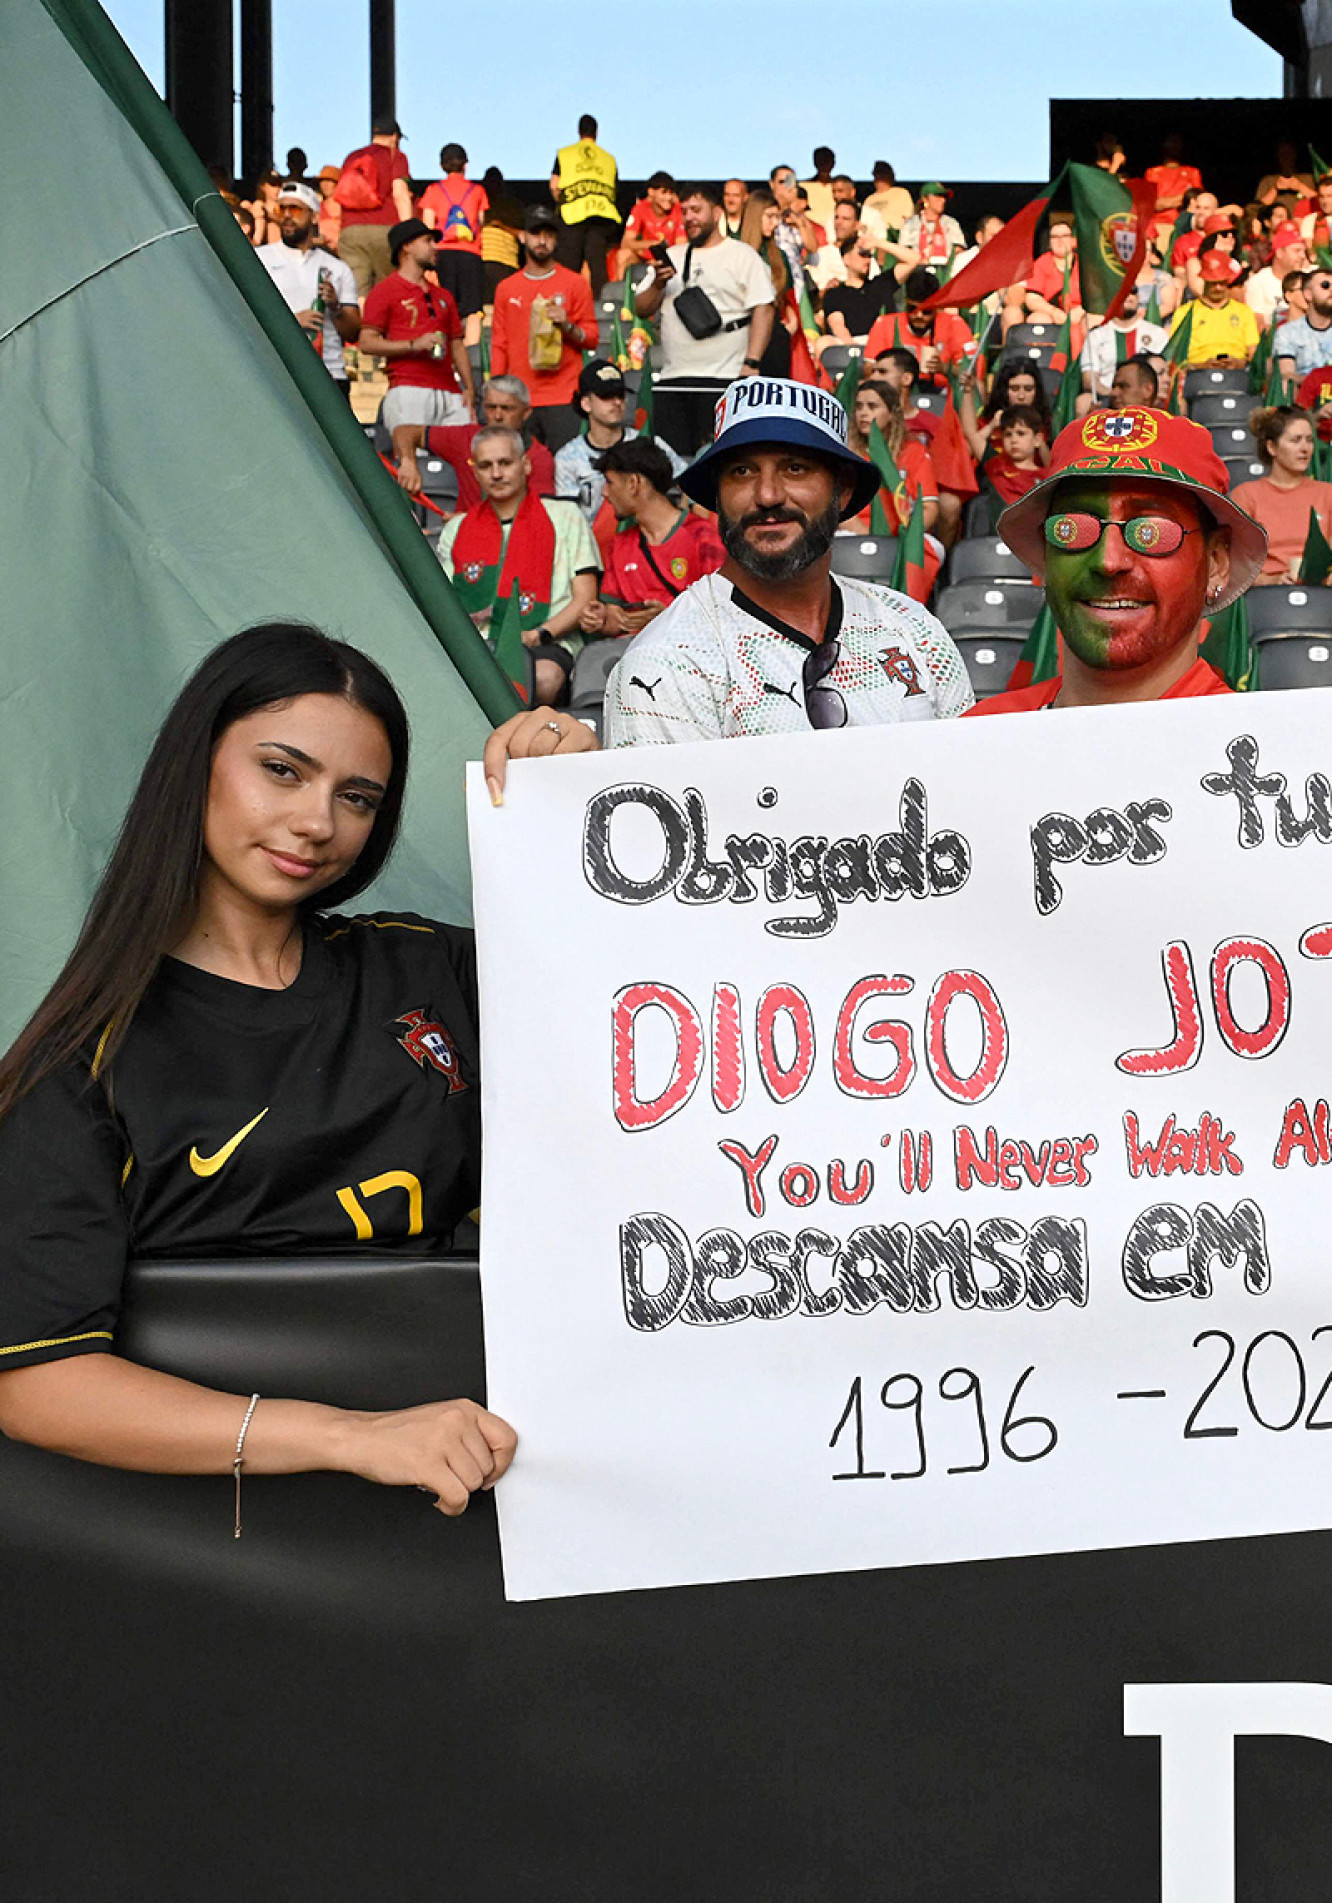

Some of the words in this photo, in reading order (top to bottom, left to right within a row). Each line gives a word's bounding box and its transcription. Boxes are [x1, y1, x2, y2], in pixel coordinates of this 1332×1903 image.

[732, 380, 848, 443] PORTUGAL
[583, 777, 972, 939] Obrigado
[1029, 798, 1172, 916] por
[611, 969, 1010, 1132] DIOGO
[718, 1129, 933, 1218] You'll
[953, 1125, 1099, 1191] Never
[1122, 1109, 1244, 1179] Walk
[619, 1212, 1089, 1332] Descansa
[829, 1366, 1057, 1480] 1996
